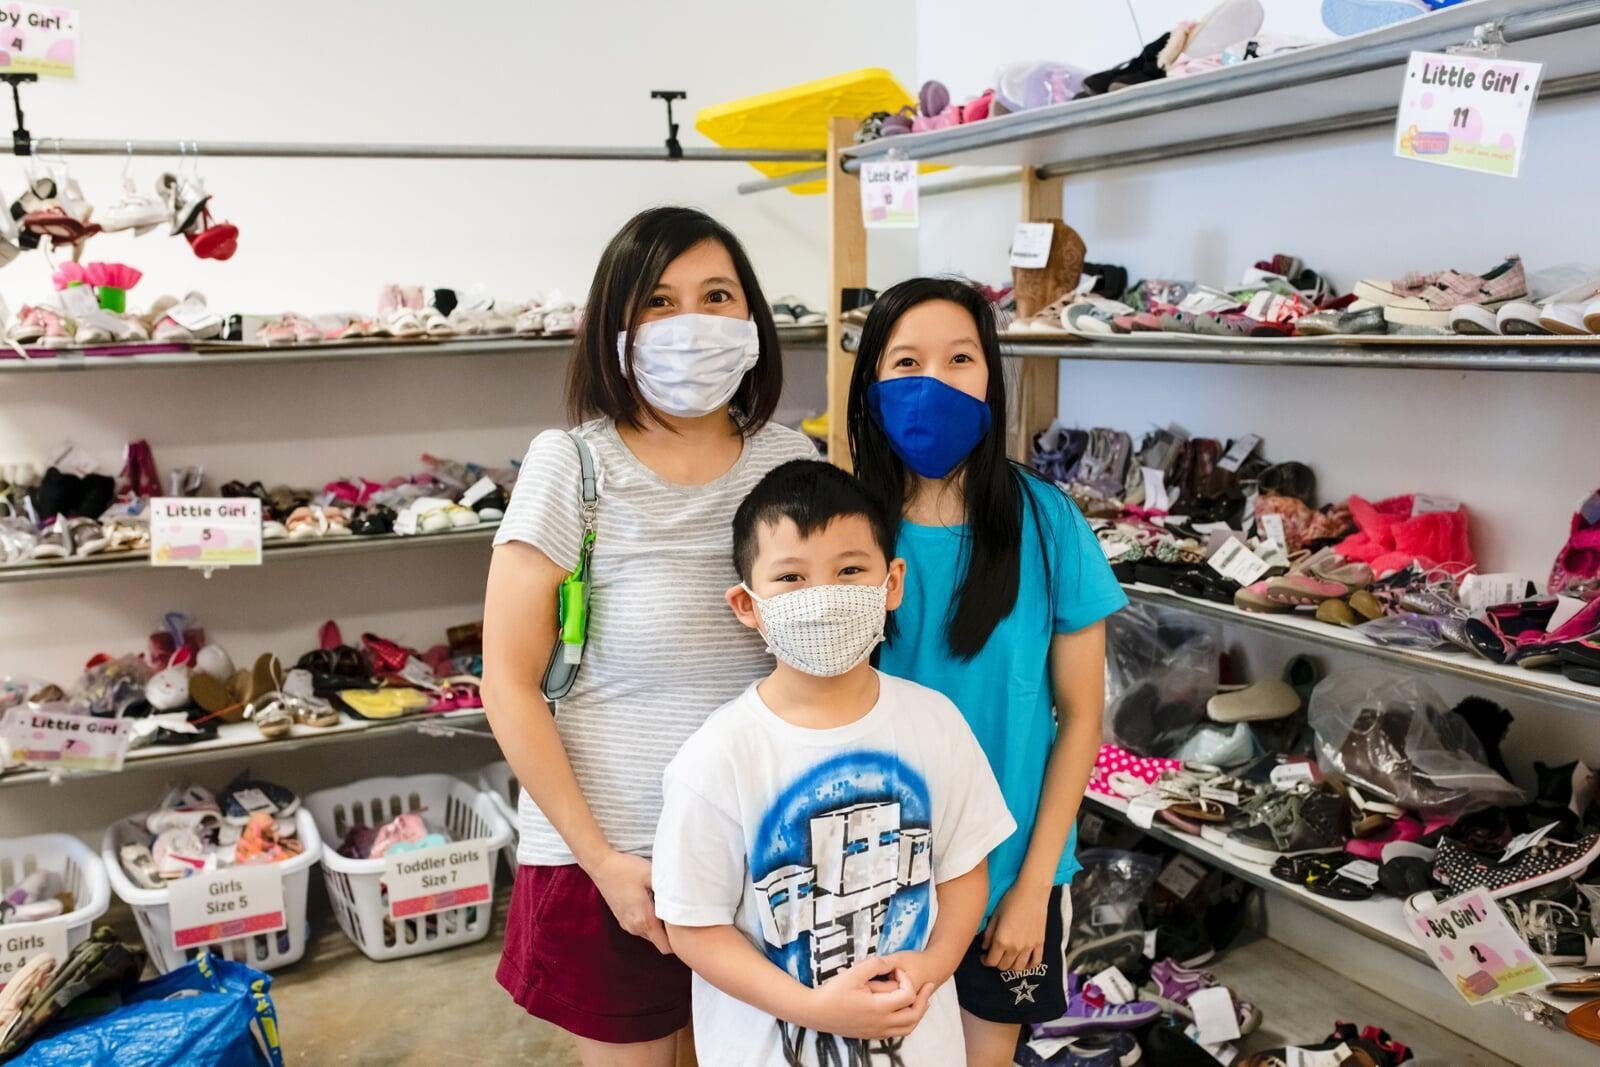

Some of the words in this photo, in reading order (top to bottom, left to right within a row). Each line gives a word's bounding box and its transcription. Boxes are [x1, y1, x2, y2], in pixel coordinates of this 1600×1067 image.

[28, 13, 60, 30] Girl
[11, 37, 22, 51] 4
[1422, 63, 1475, 88] Little
[1482, 69, 1520, 94] Girl
[1453, 107, 1470, 128] 11
[166, 505, 212, 517] Little
[218, 505, 246, 517] Girl
[202, 528, 212, 540] 5
[31, 717, 80, 731] Little
[86, 722, 118, 735] Girl
[65, 739, 76, 749] 7
[396, 857, 446, 876] Toddler
[449, 850, 479, 866] Girls
[209, 880, 243, 896] Girls
[421, 875, 447, 888] Size
[450, 870, 458, 882] 7
[206, 901, 235, 915] Size
[239, 895, 248, 908] 5
[1427, 919, 1457, 940] Big
[1450, 903, 1482, 929] Girl
[7, 935, 44, 952] Girls
[1469, 945, 1487, 963] 2
